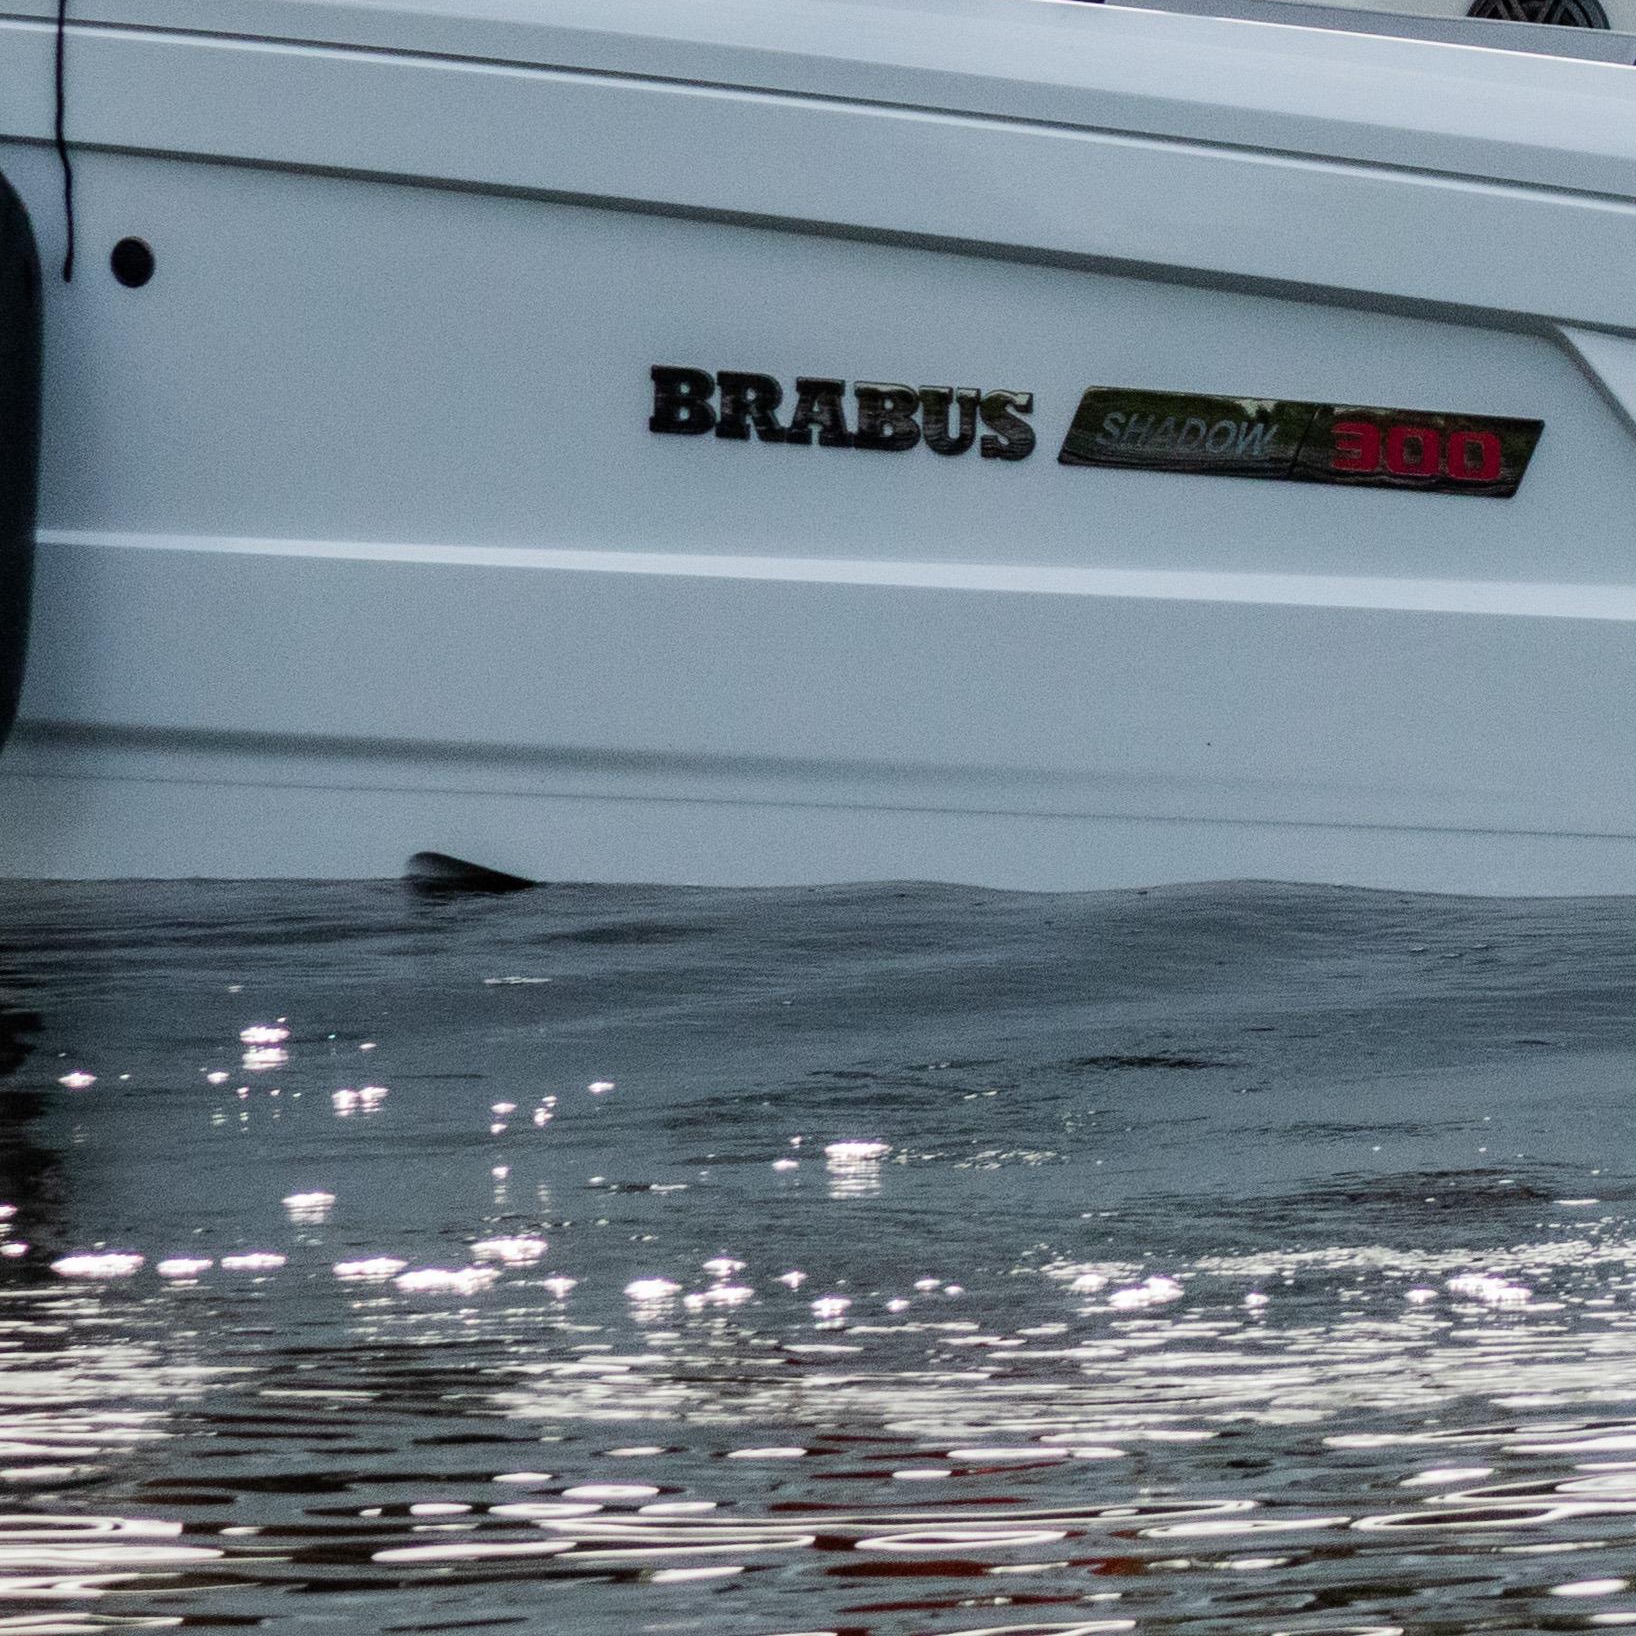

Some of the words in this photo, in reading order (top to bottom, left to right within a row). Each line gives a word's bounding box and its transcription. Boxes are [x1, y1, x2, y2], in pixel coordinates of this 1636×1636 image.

[648, 364, 1035, 462] BRABUS
[1096, 411, 1278, 458] SHADOW
[1331, 421, 1502, 481] 300
